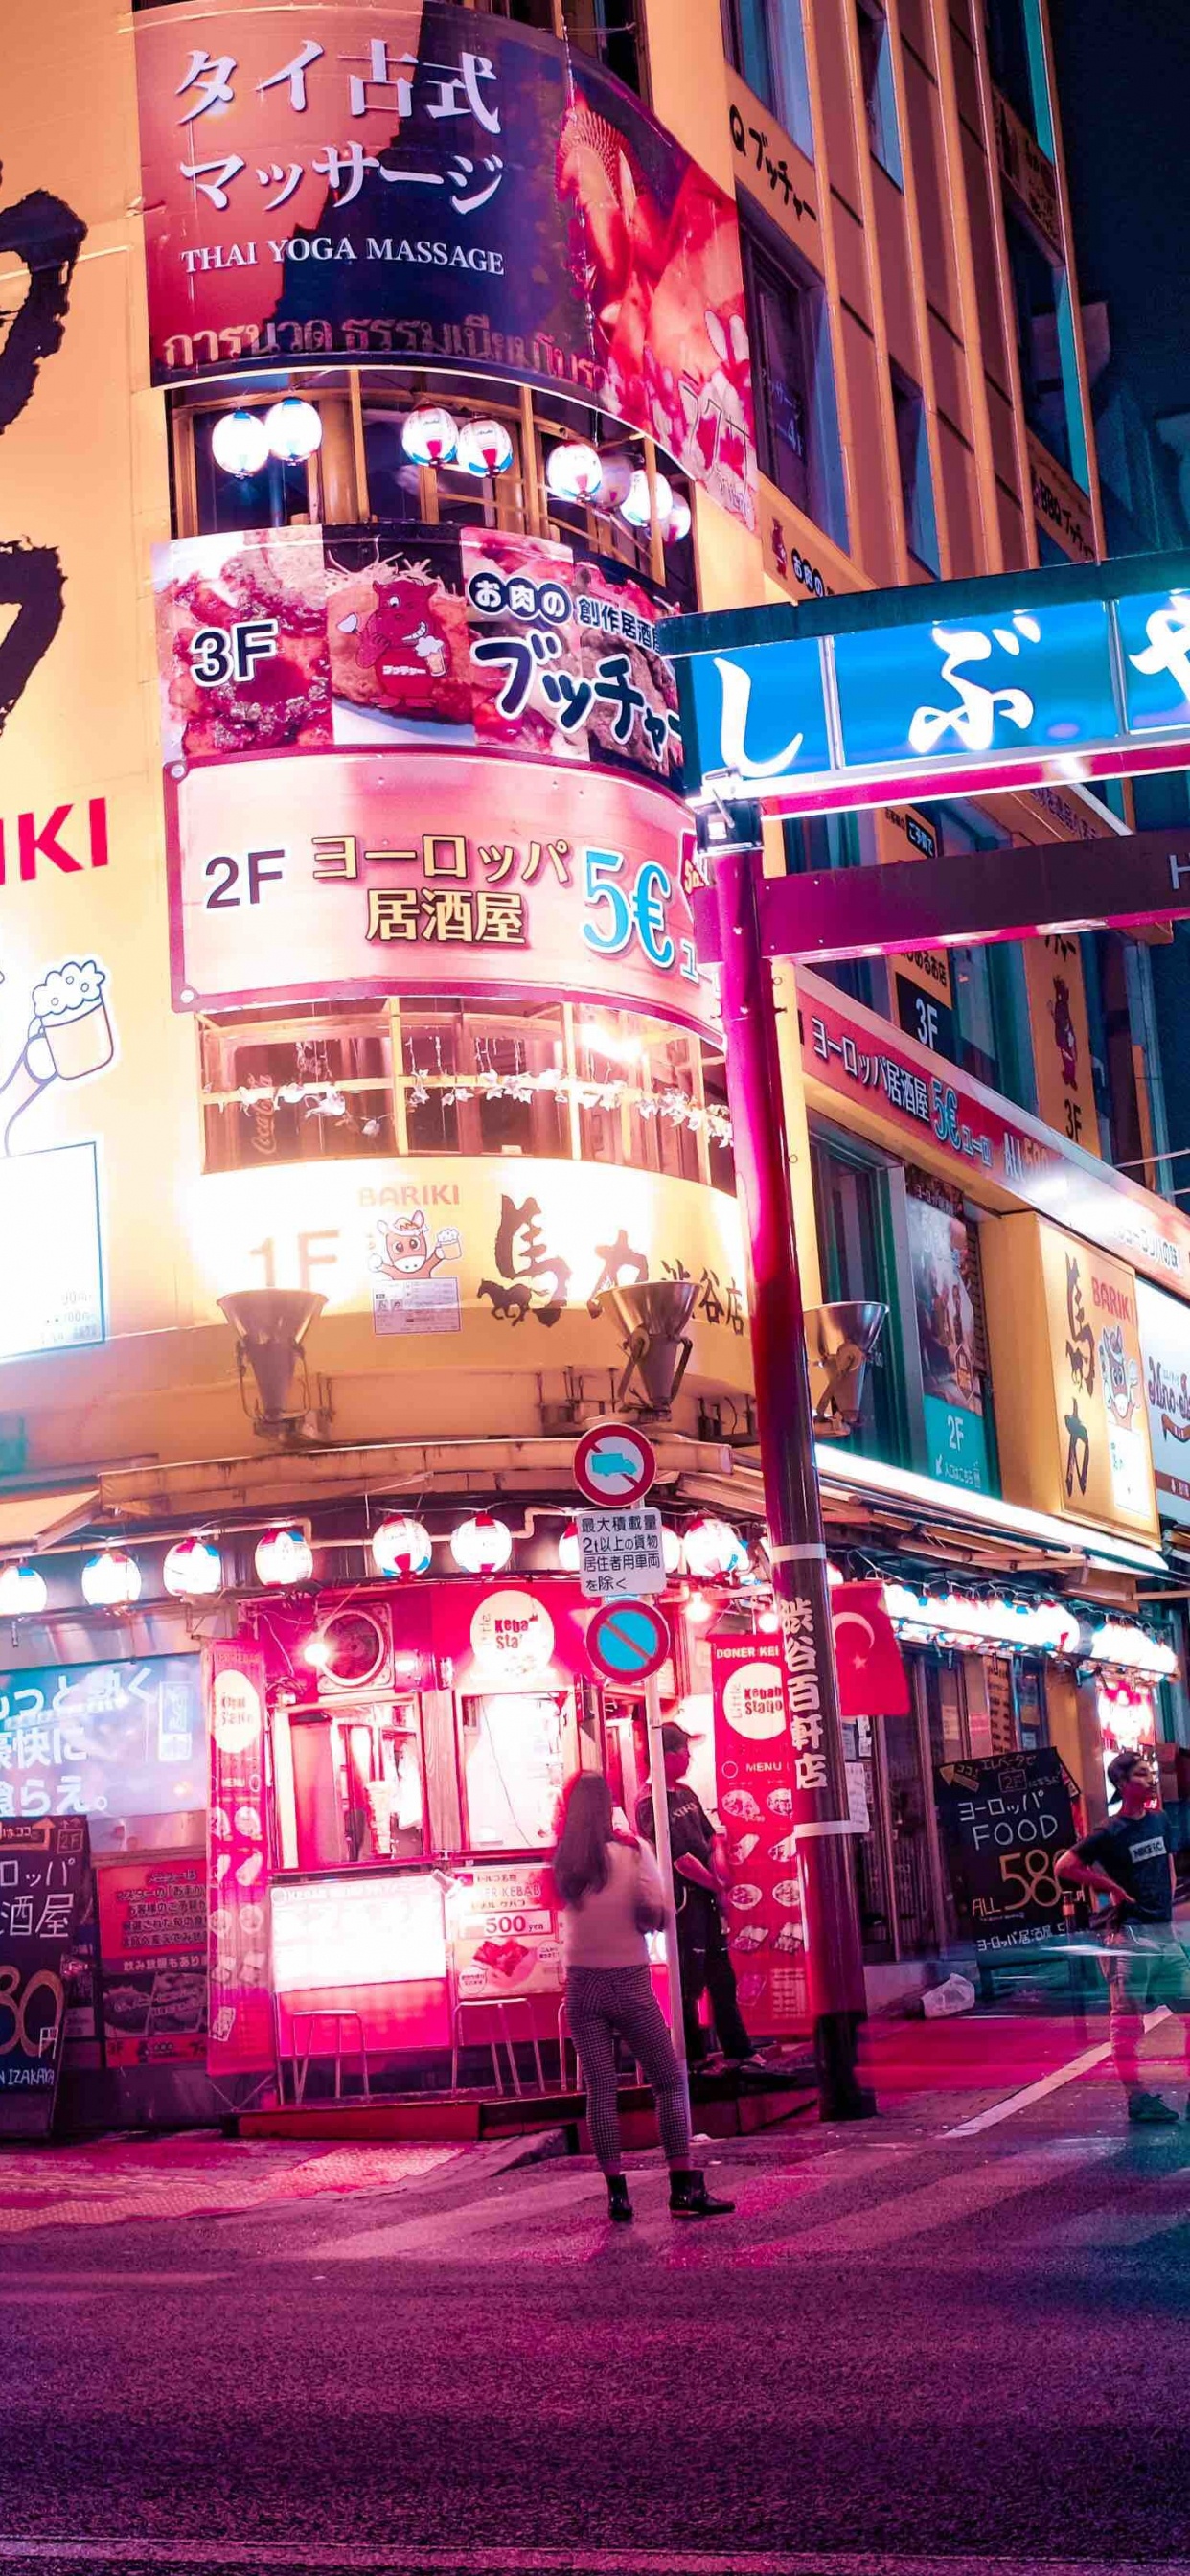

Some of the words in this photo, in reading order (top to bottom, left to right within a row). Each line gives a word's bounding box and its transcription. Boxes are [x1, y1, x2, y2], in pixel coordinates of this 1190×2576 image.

[175, 39, 501, 134] タイ古式
[180, 140, 503, 215] マッサージ
[182, 242, 257, 274] THAI
[266, 237, 356, 263] YOGA
[365, 237, 505, 276] MASSAGE
[475, 577, 567, 618] お肉の
[195, 624, 276, 682] 3F
[312, 834, 571, 884] ヨーロッパ
[205, 851, 286, 909] 2F
[367, 887, 526, 944] 居酒屋
[582, 846, 675, 963] 5€
[916, 998, 938, 1049] 3F
[812, 1017, 930, 1122] ヨーロッパ居酒屋
[1064, 1099, 1083, 1140] 3F
[358, 1184, 460, 1207] BARIKI
[250, 1230, 339, 1289] 1F
[947, 1414, 964, 1452] 2F
[582, 1514, 656, 1532] 最大積載量
[583, 1534, 658, 1552] 2t以上の貨物
[584, 1553, 660, 1572] 居住者用車両
[585, 1575, 627, 1591] を除く
[495, 1619, 530, 1634] Keba
[717, 1647, 755, 1659] DONER
[744, 1687, 783, 1700] Kebab
[744, 1700, 783, 1715] Statio
[780, 1597, 828, 1790] 渋谷百軒店
[745, 1761, 782, 1773] MENU
[958, 1789, 1044, 1821] ヨーロッパ
[973, 1814, 1058, 1851] FOOD
[0, 1858, 75, 1887] ロッパ
[502, 1884, 540, 1897] KEBAB
[972, 1896, 1001, 1917] ALL
[999, 1849, 1069, 1911] 58
[485, 1915, 526, 1933] 500
[528, 1923, 544, 1932] yen
[9, 2068, 55, 2085] IZAKAYA
